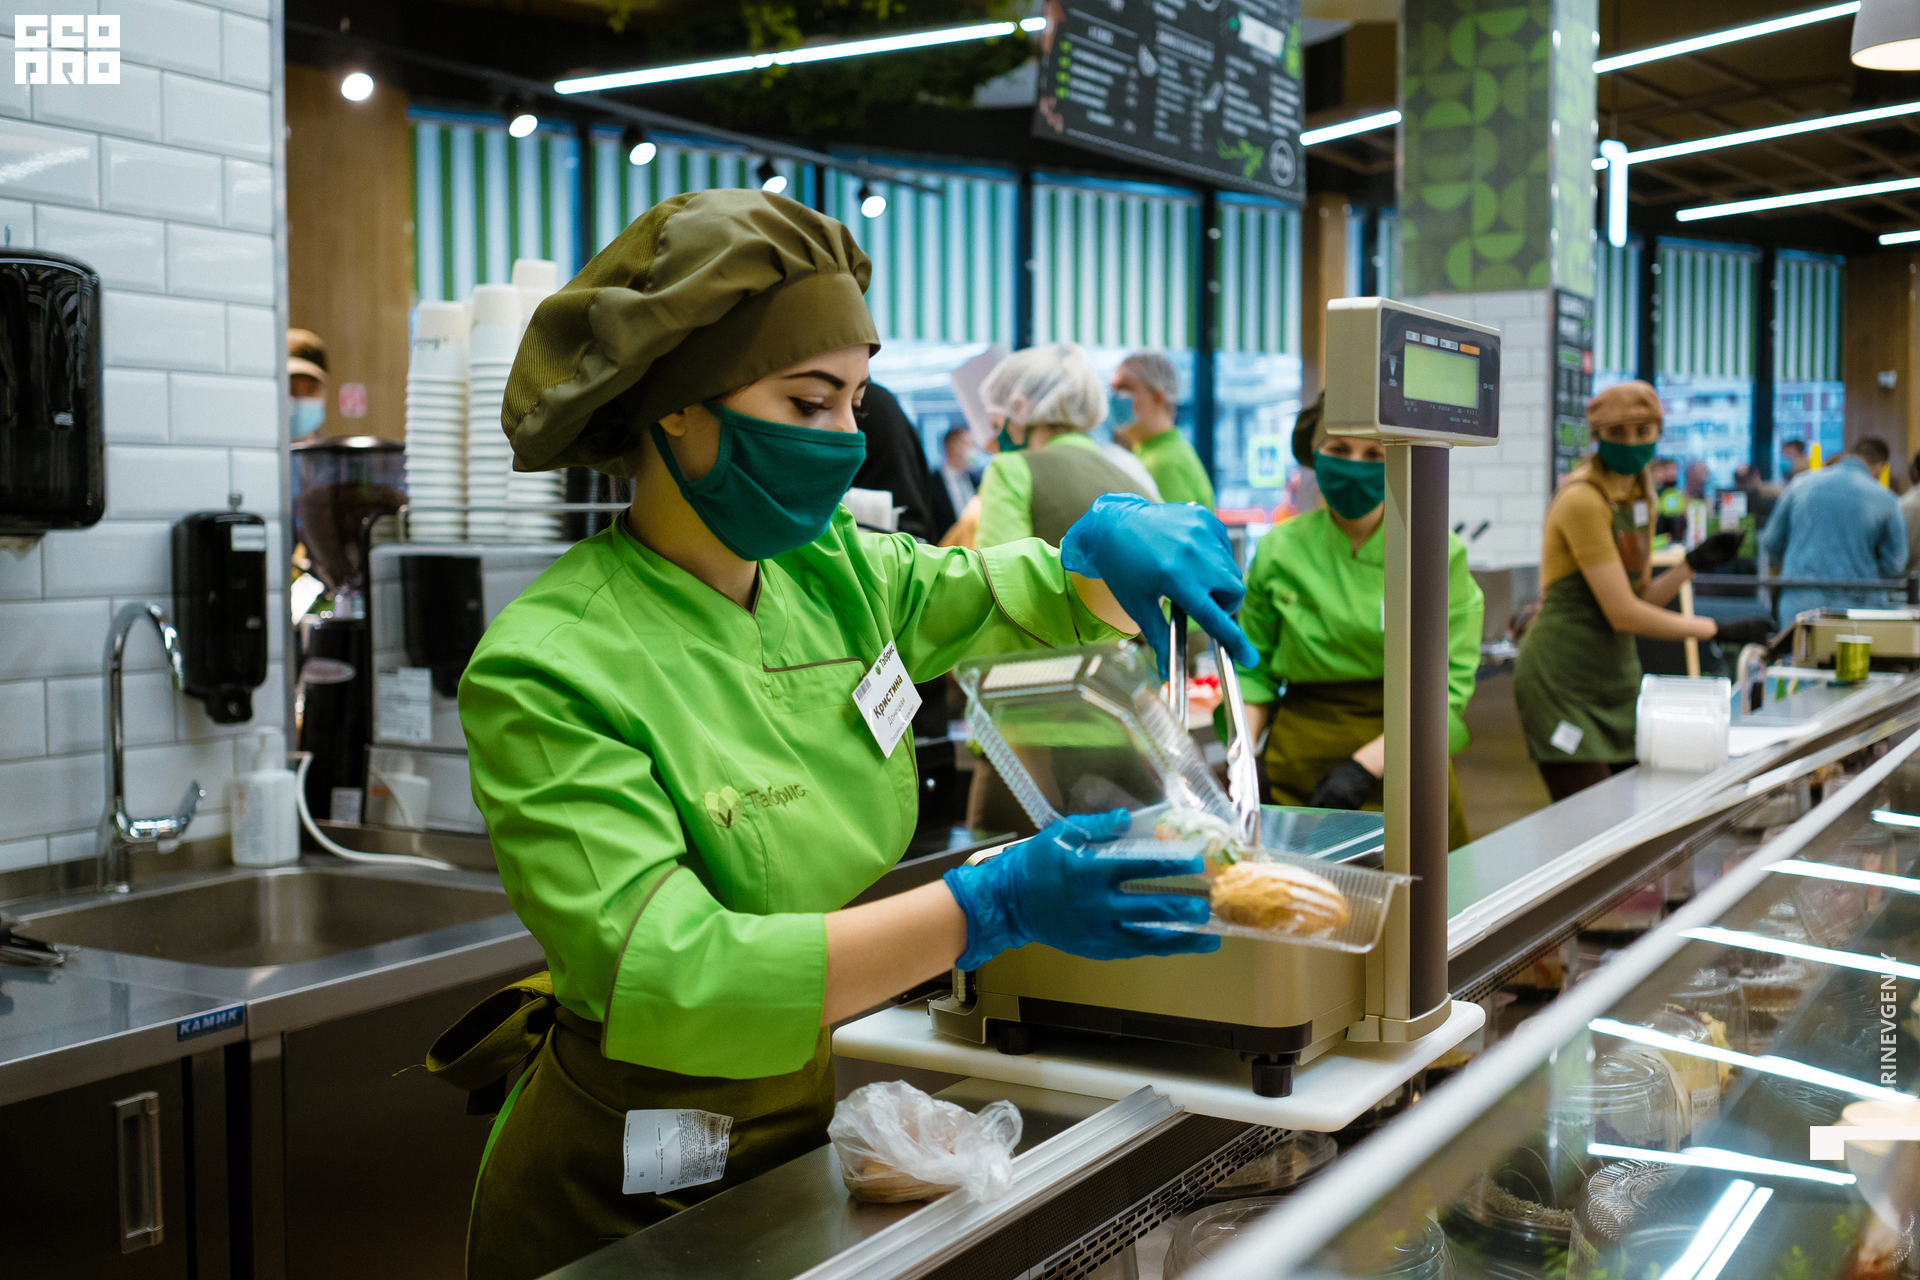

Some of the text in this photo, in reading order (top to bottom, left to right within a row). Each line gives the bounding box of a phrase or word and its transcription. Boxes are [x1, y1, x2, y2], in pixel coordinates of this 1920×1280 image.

[879, 645, 895, 668] Табрис
[873, 674, 903, 719] Кристина
[745, 782, 807, 811] Табрис
[180, 1009, 237, 1036] КАМИК
